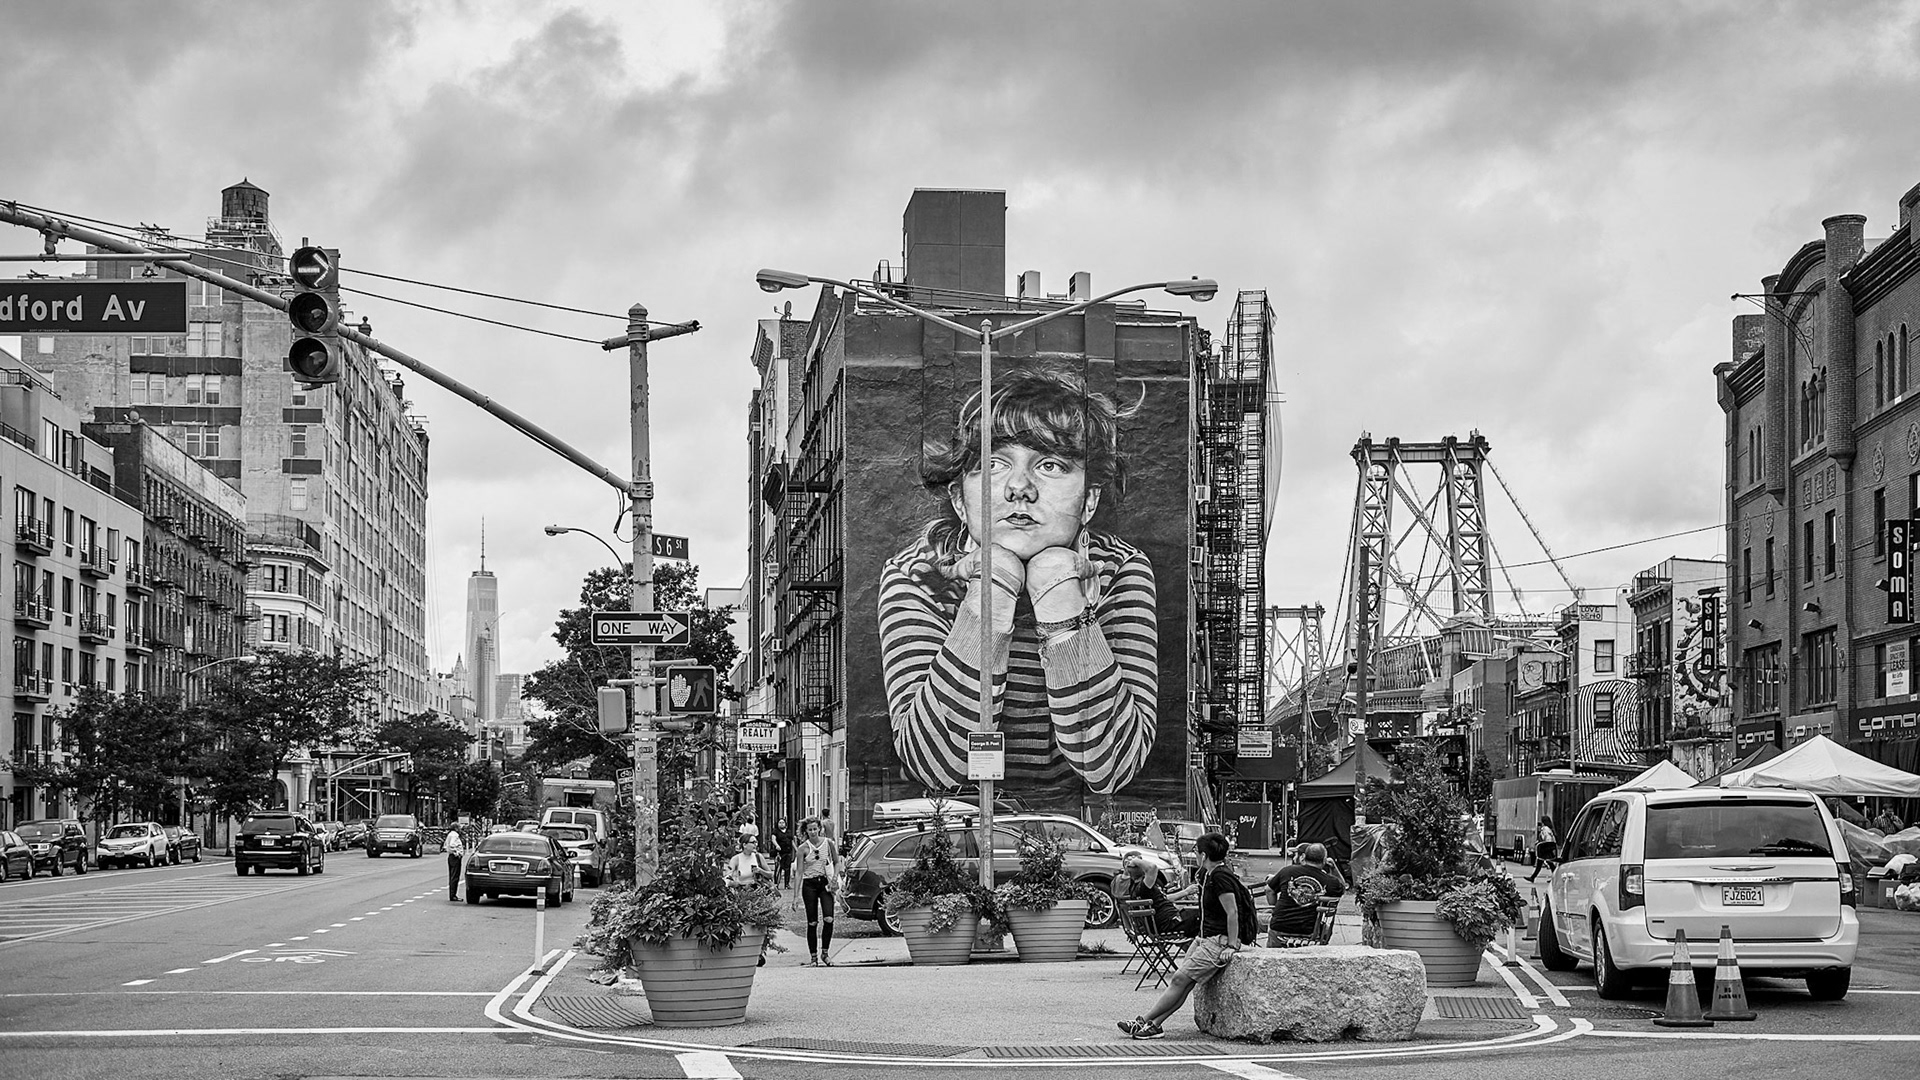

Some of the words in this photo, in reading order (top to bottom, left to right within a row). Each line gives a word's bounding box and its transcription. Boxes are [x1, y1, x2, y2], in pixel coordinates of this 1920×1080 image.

[0, 294, 83, 321] dford
[101, 294, 146, 321] Av
[656, 536, 662, 555] S
[666, 537, 672, 556] 6
[675, 539, 683, 549] St
[1890, 526, 1906, 617] SOMA
[601, 622, 631, 635] ONE
[648, 622, 678, 635] WAY
[742, 728, 774, 738] REALTY
[1724, 890, 1762, 901] FJZ6021
